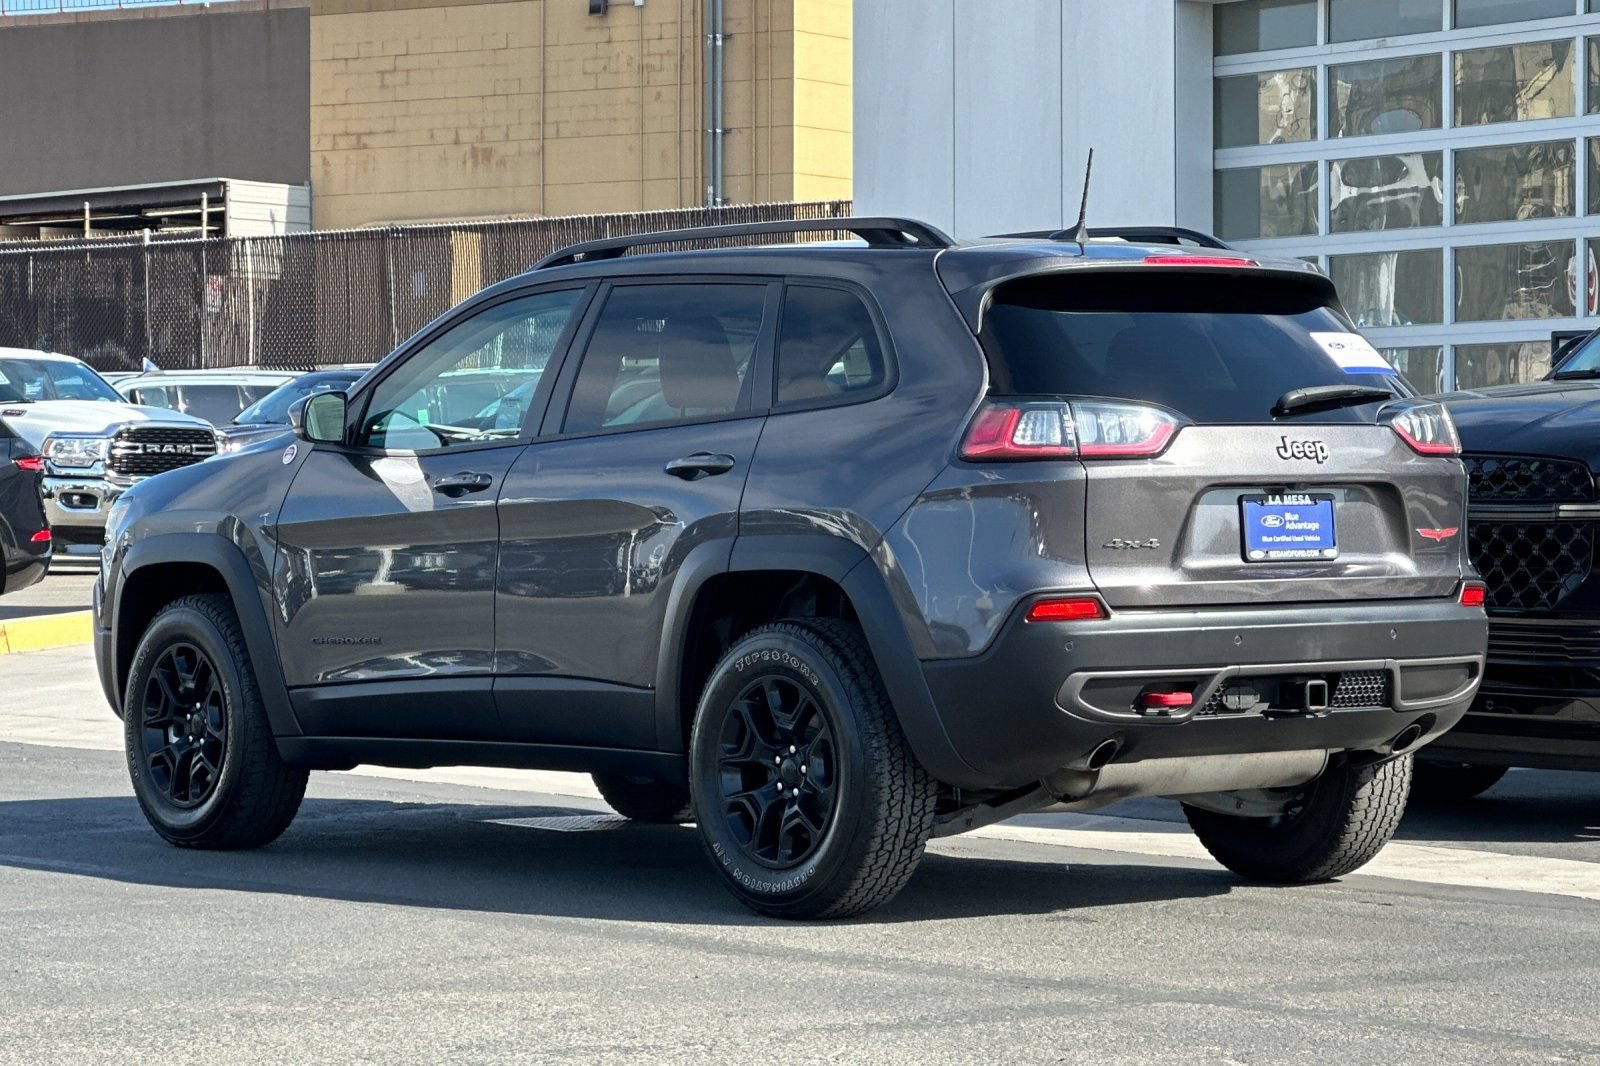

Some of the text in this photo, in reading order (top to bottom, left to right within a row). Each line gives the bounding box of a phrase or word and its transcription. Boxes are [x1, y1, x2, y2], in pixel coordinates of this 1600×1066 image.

[146, 444, 191, 454] RAM
[1276, 435, 1329, 464] Jeep
[1268, 494, 1311, 505] LA MESA
[1284, 512, 1299, 521] Blue
[1285, 521, 1320, 531] Advantage
[312, 637, 382, 645] CHEROKEE
[712, 841, 816, 892] DESTINATION A/T
